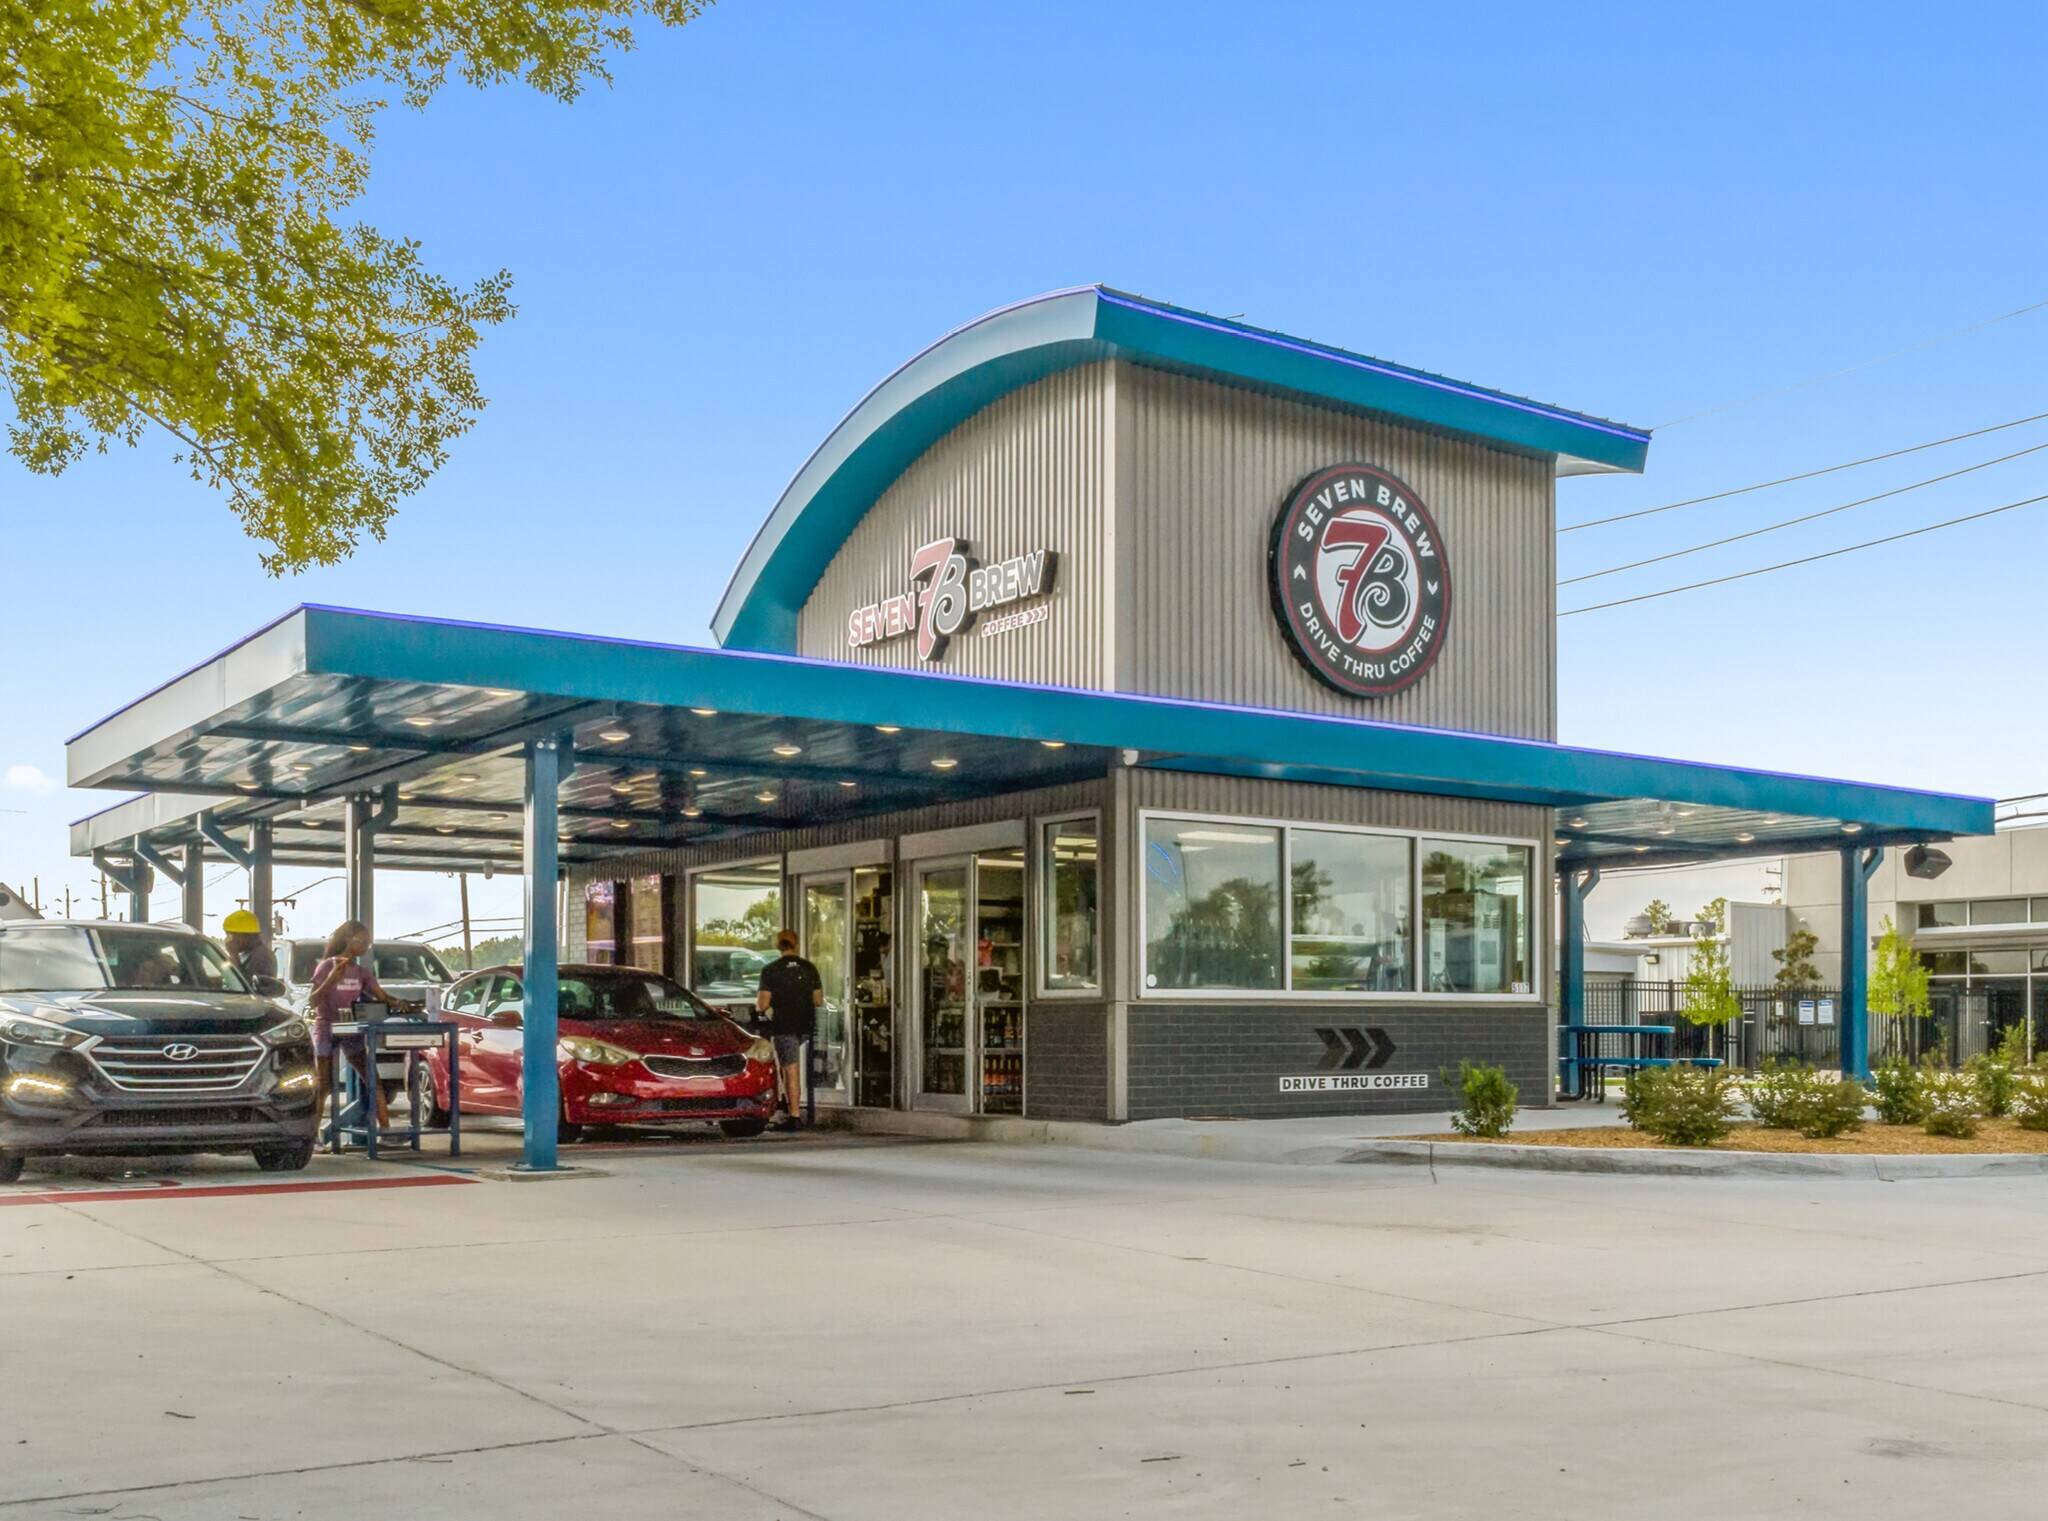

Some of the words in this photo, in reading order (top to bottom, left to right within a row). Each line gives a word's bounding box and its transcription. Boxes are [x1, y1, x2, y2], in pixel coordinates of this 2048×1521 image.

[1298, 479, 1366, 542] SEVEN
[1376, 485, 1435, 558] BREW
[849, 591, 916, 647] SEVEN
[970, 550, 1045, 611] BREW
[982, 614, 1024, 635] COFFEE
[1300, 602, 1341, 662] DRIVE
[1343, 655, 1385, 679] THRU
[1389, 614, 1435, 675] COFFEE
[1282, 1078, 1326, 1089] DRIVE
[1331, 1077, 1369, 1088] THRU
[1374, 1075, 1426, 1087] COFFEE
